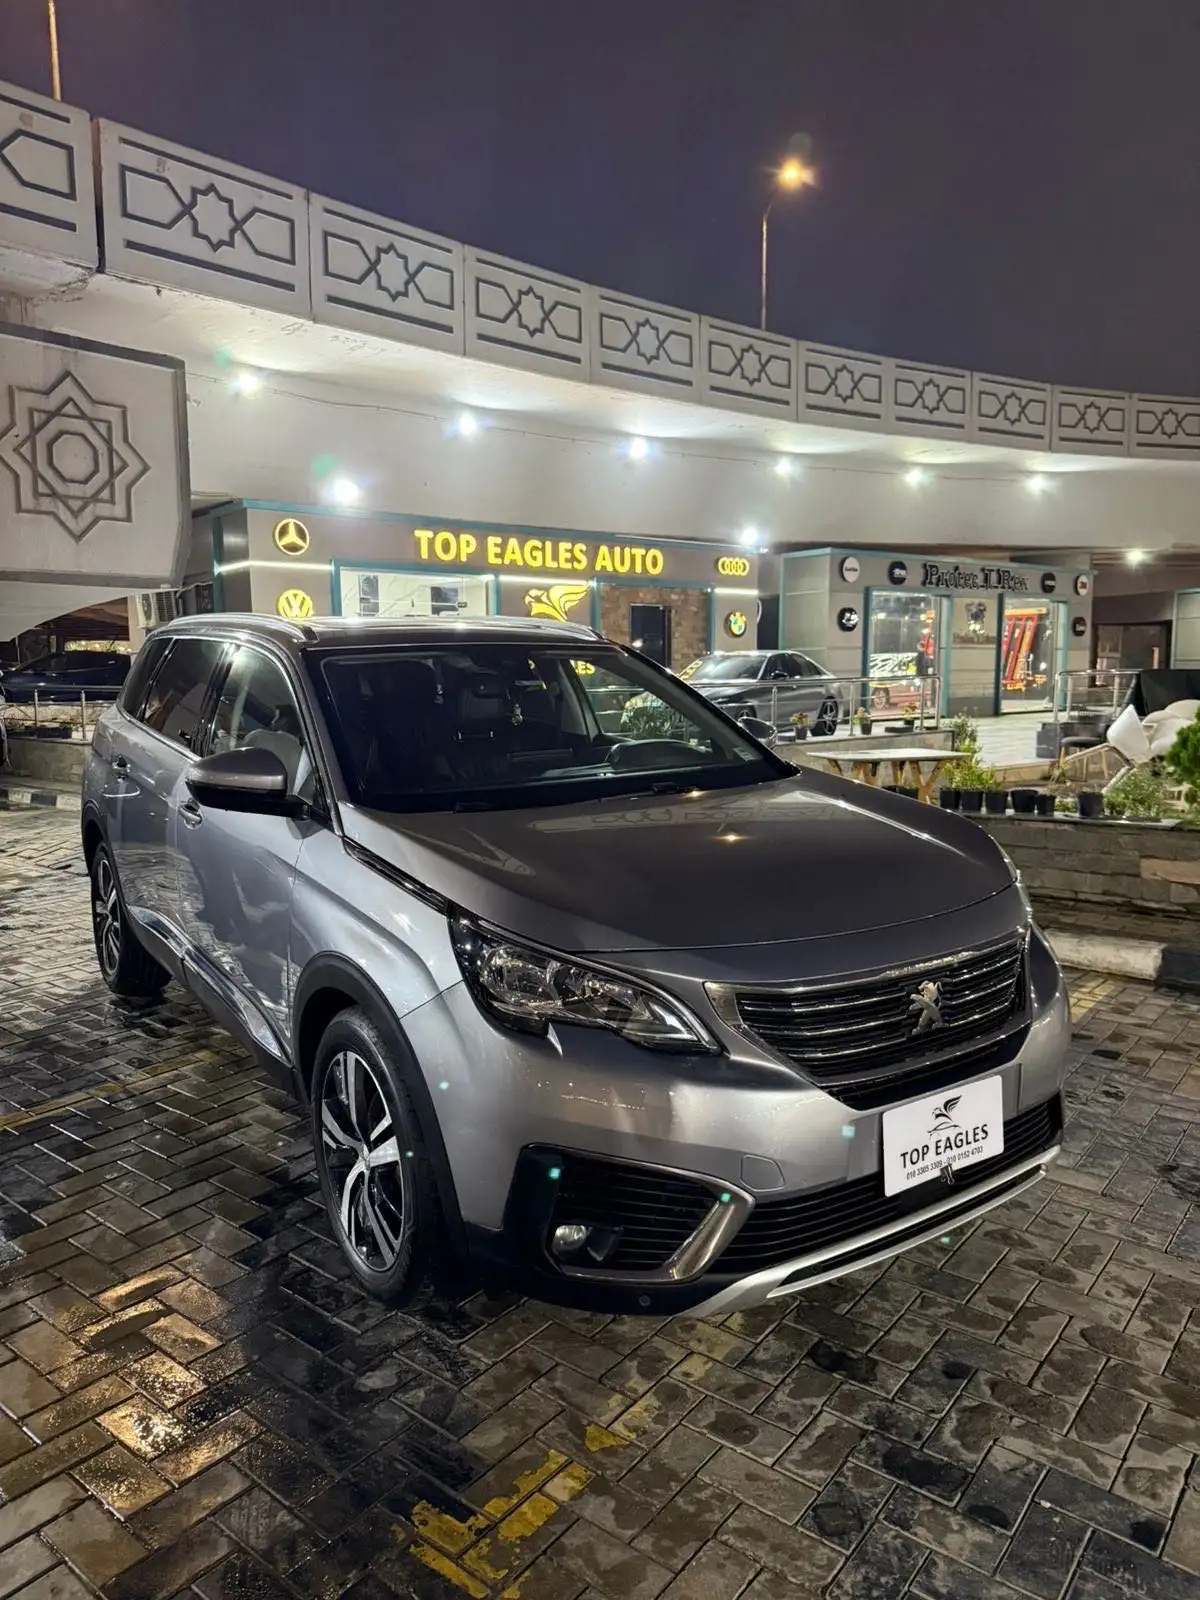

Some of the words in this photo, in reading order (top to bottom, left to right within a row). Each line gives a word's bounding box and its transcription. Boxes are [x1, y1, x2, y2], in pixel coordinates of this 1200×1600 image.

[414, 530, 476, 562] TOP
[486, 536, 588, 571] EAGLES
[594, 545, 664, 575] AUTO
[900, 1144, 930, 1169] TOP
[935, 1123, 989, 1156] EAGLES
[906, 1169, 917, 1180] 010
[957, 1150, 970, 1161] 0152
